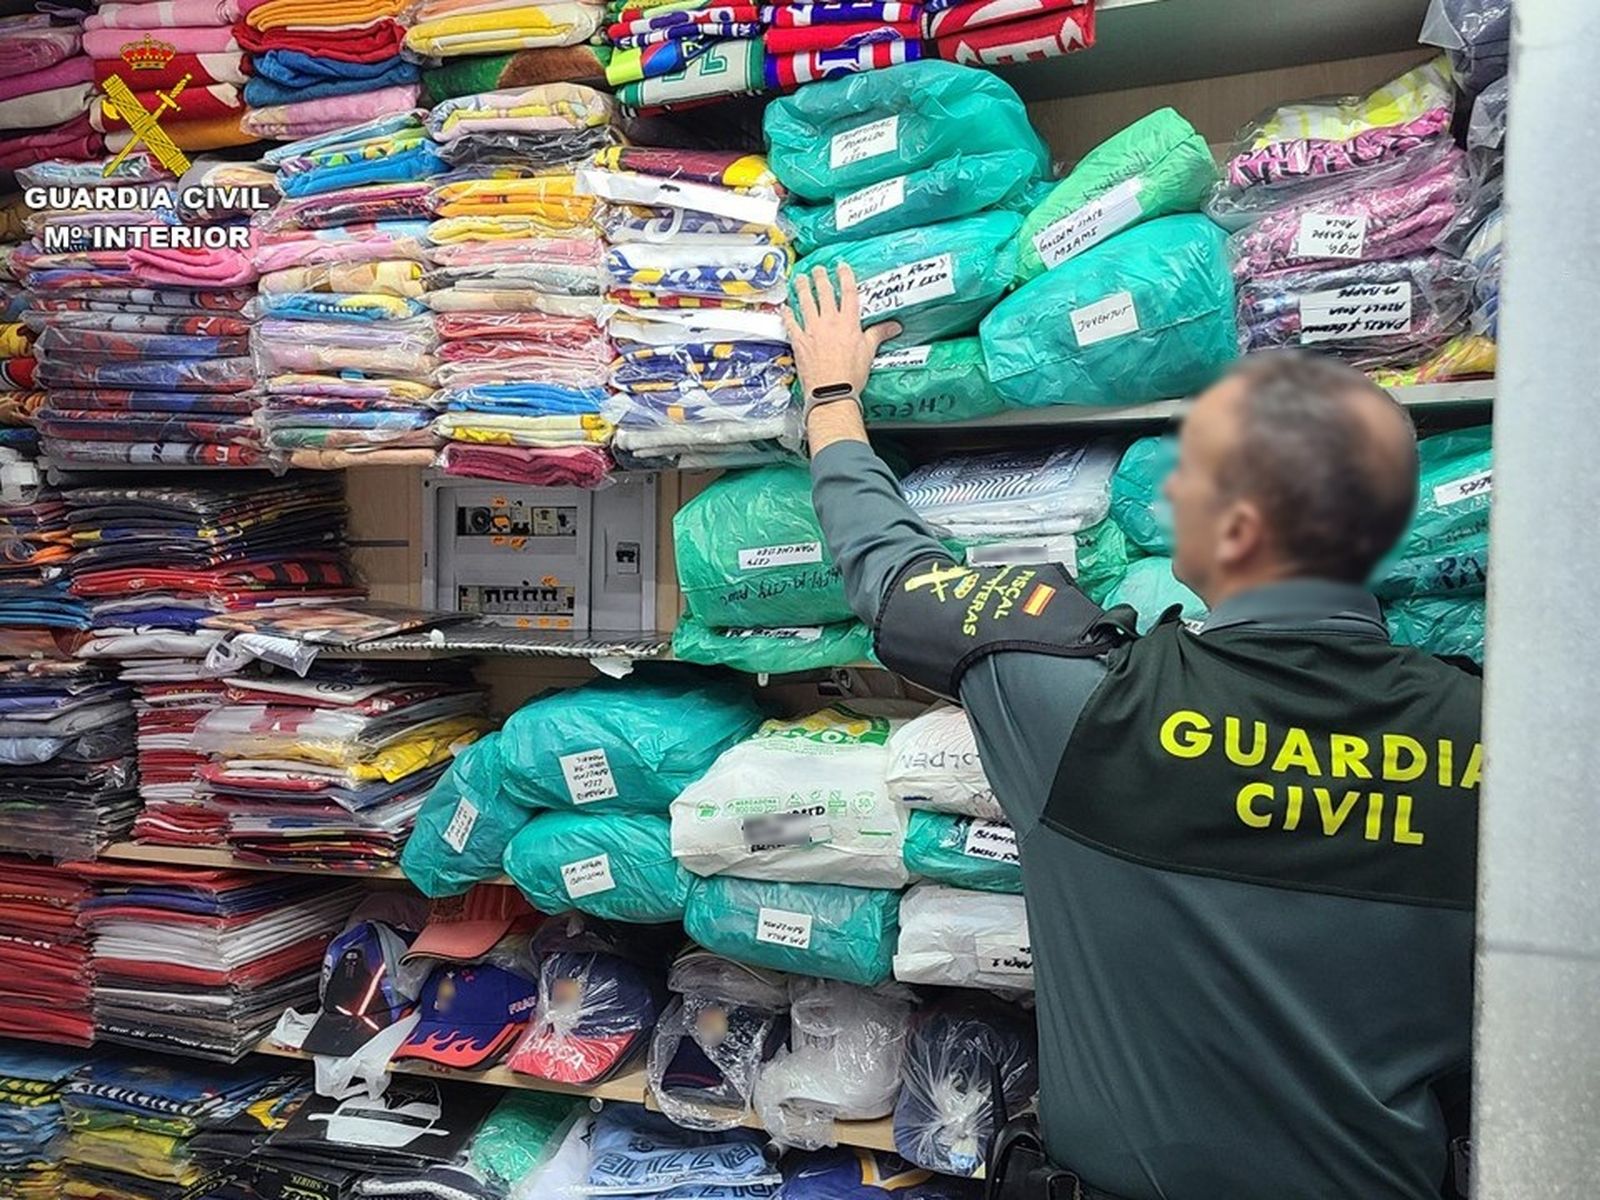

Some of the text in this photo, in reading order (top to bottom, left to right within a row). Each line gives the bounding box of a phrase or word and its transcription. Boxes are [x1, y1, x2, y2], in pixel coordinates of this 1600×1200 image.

[1053, 226, 1099, 261] MIAMI
[901, 751, 979, 772] OLDEN
[1235, 782, 1425, 845] CIVIL
